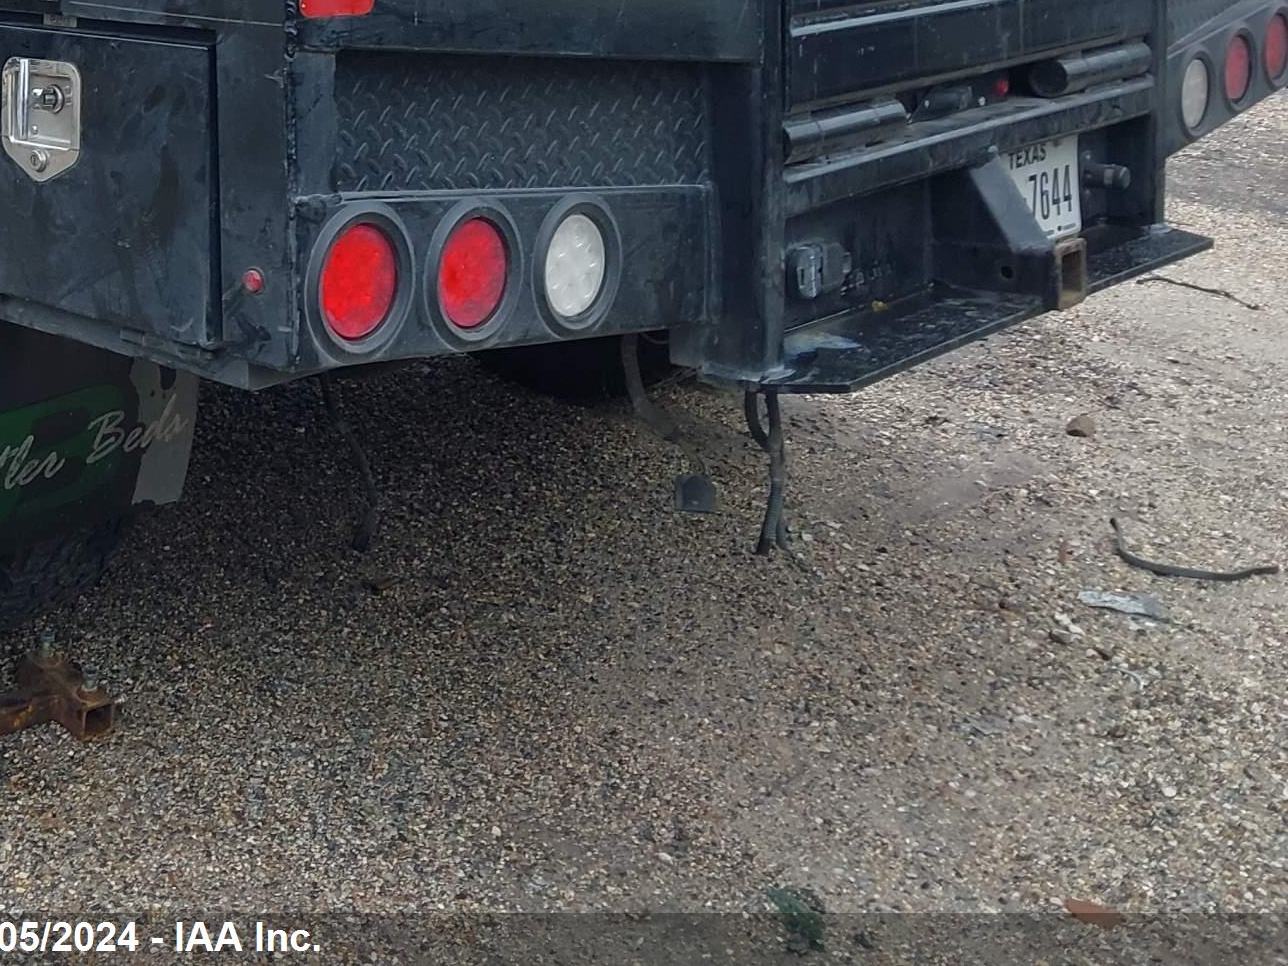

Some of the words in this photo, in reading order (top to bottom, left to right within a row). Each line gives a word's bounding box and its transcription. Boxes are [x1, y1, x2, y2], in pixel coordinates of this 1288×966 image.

[1008, 143, 1048, 171] TEXAS
[1028, 164, 1073, 220] 7644
[85, 392, 190, 465] Beds
